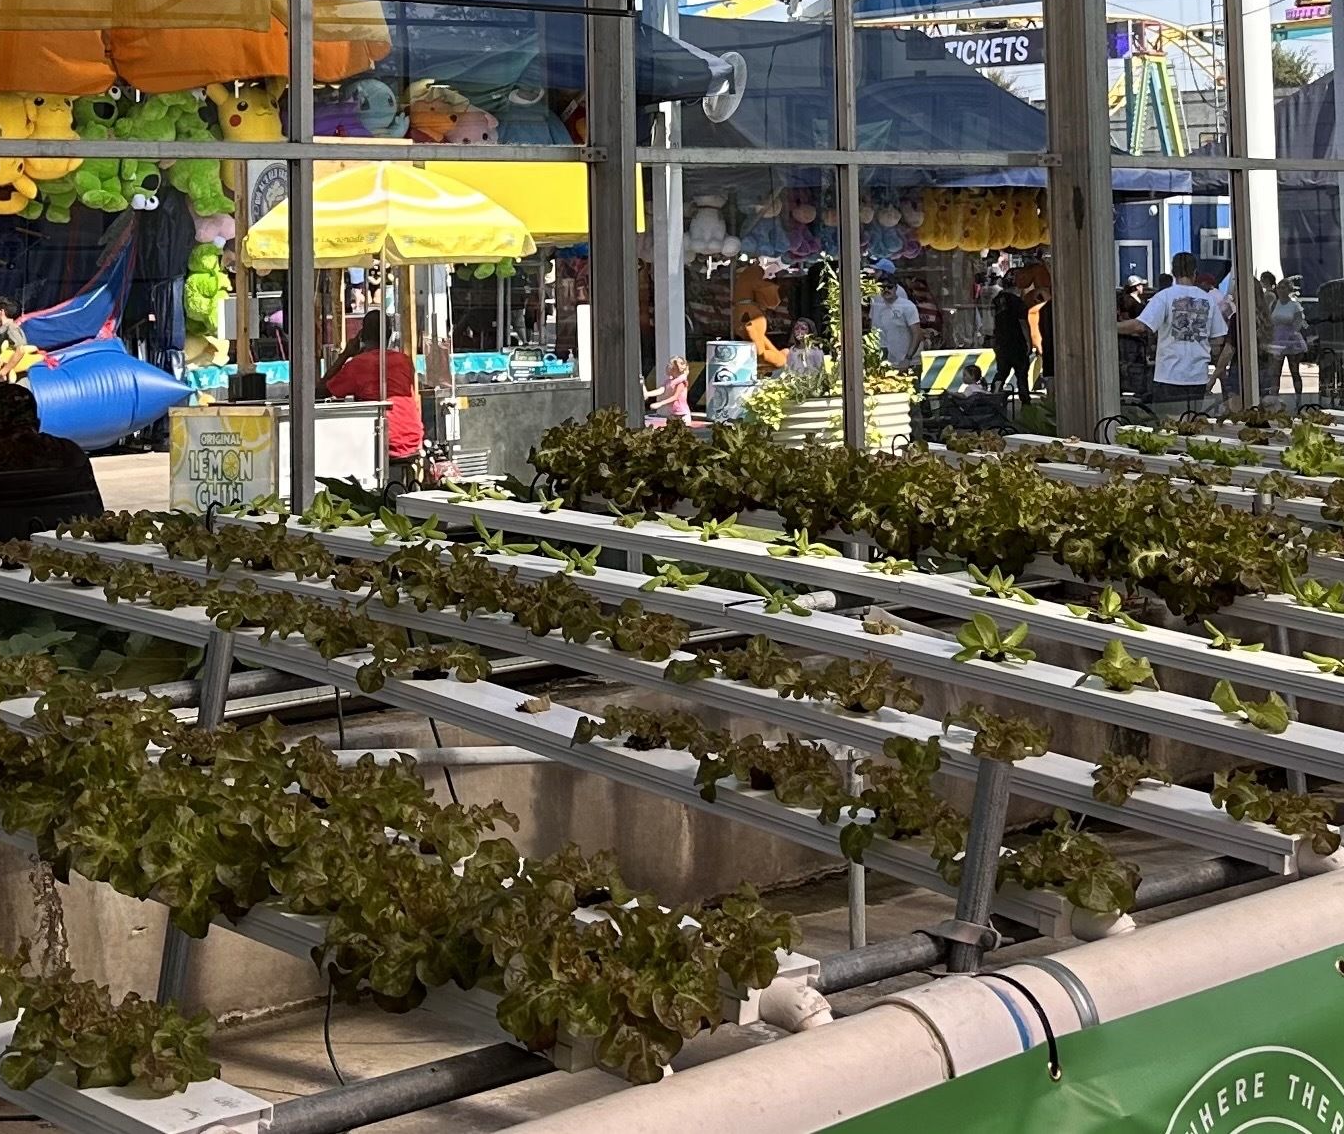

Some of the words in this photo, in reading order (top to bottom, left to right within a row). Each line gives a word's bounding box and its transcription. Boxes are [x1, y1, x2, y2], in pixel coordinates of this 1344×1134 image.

[944, 35, 1029, 65] TICKETS
[200, 432, 242, 446] ORIGINAL
[188, 448, 253, 481] LEMON
